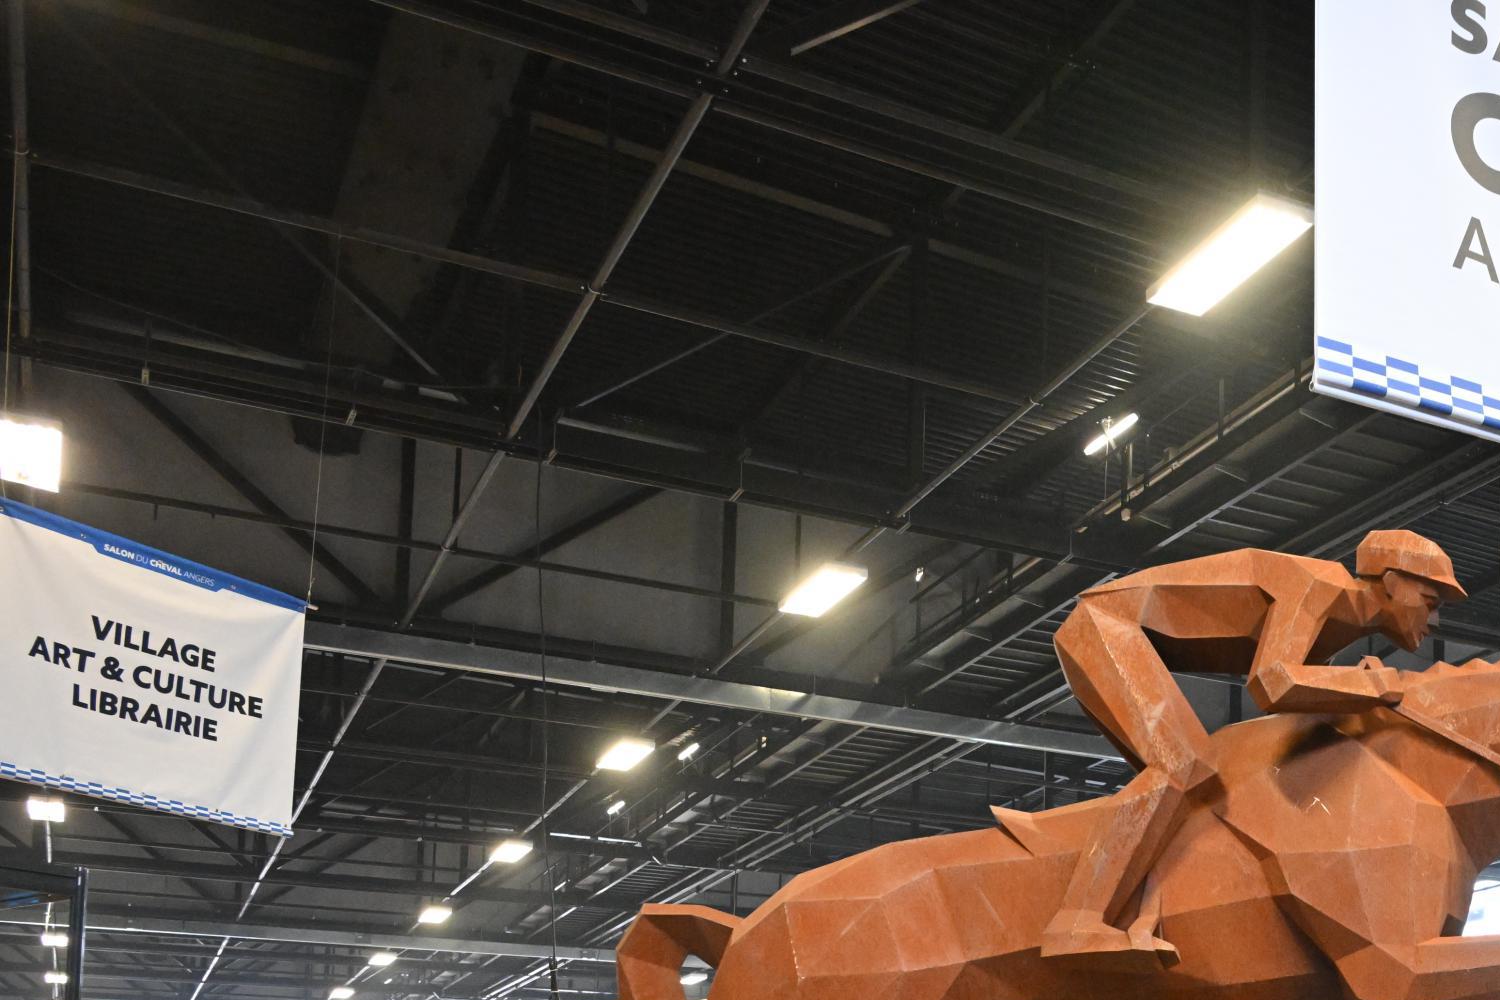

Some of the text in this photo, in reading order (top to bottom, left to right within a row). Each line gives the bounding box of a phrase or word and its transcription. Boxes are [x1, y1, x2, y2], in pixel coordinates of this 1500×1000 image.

[103, 543, 216, 587] SALON DU CHEVAL ANGERS
[91, 614, 217, 673] VILLAGE
[28, 635, 264, 719] ART & CULTURE
[71, 683, 218, 742] LIBRAIRIE
